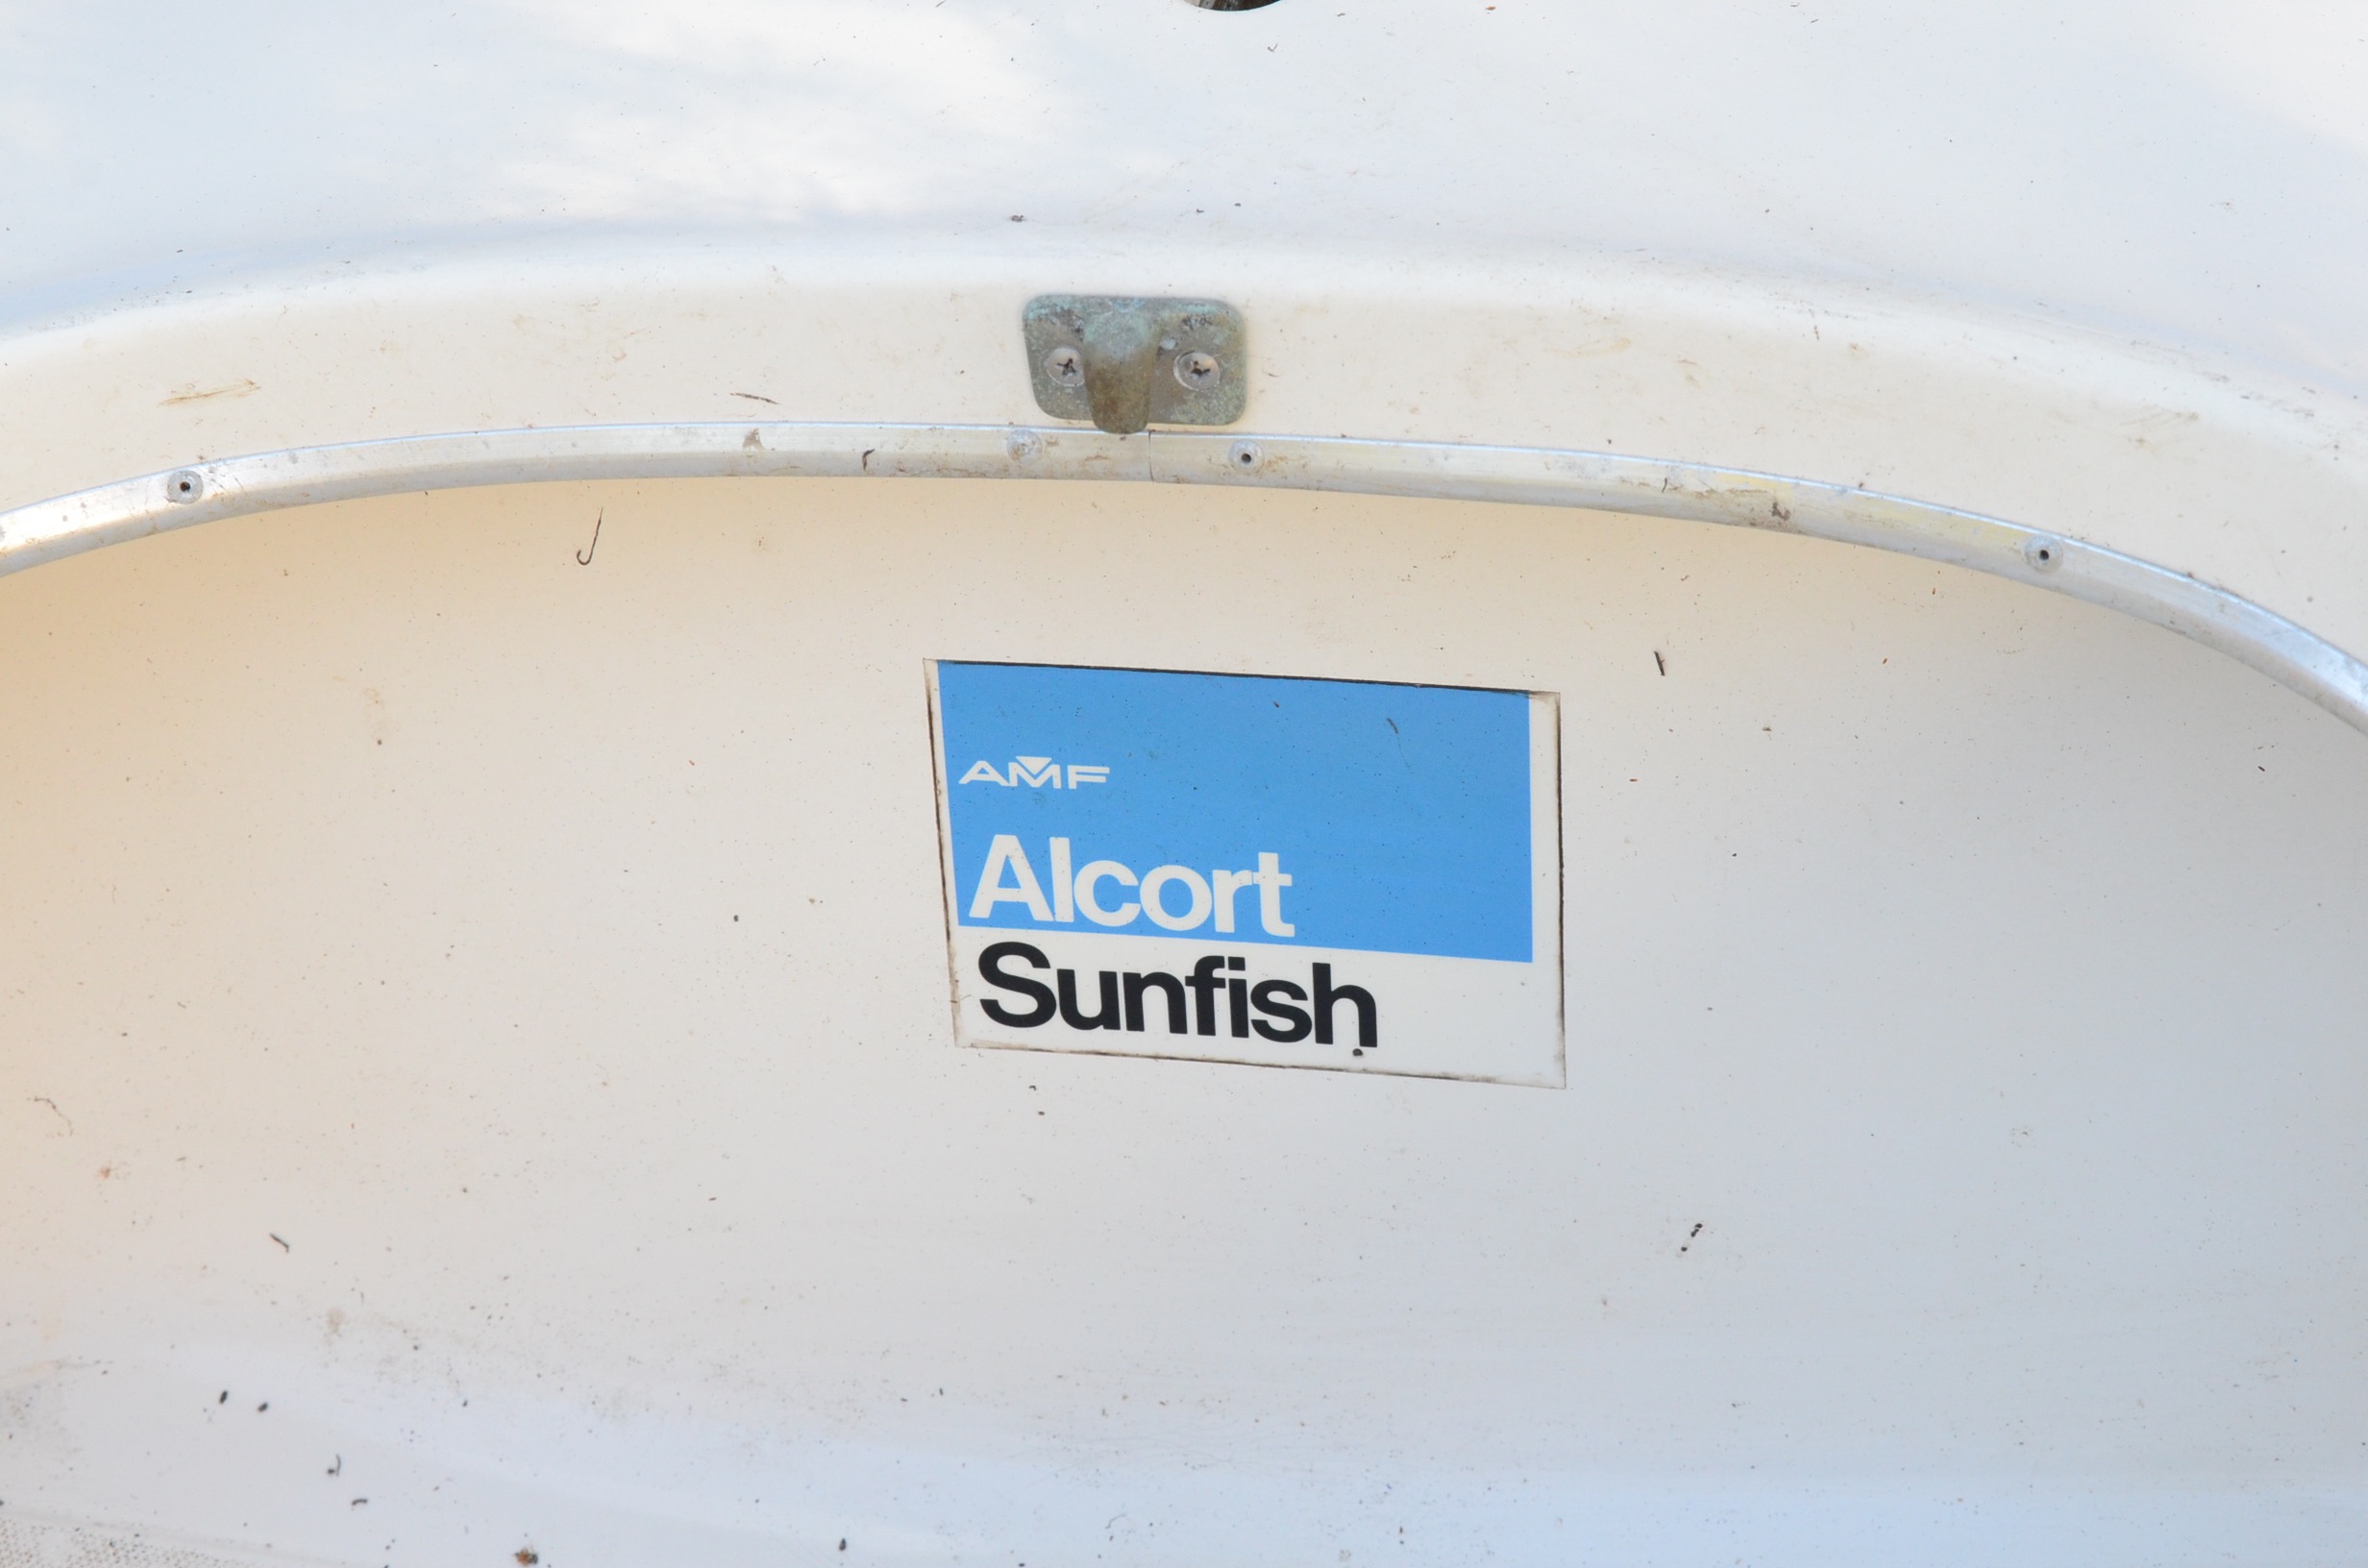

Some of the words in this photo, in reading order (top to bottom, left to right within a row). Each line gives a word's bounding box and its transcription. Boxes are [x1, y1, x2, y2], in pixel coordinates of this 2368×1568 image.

[958, 756, 1110, 790] AMF
[969, 834, 1295, 938] Alcort
[978, 941, 1378, 1048] Sunfish
